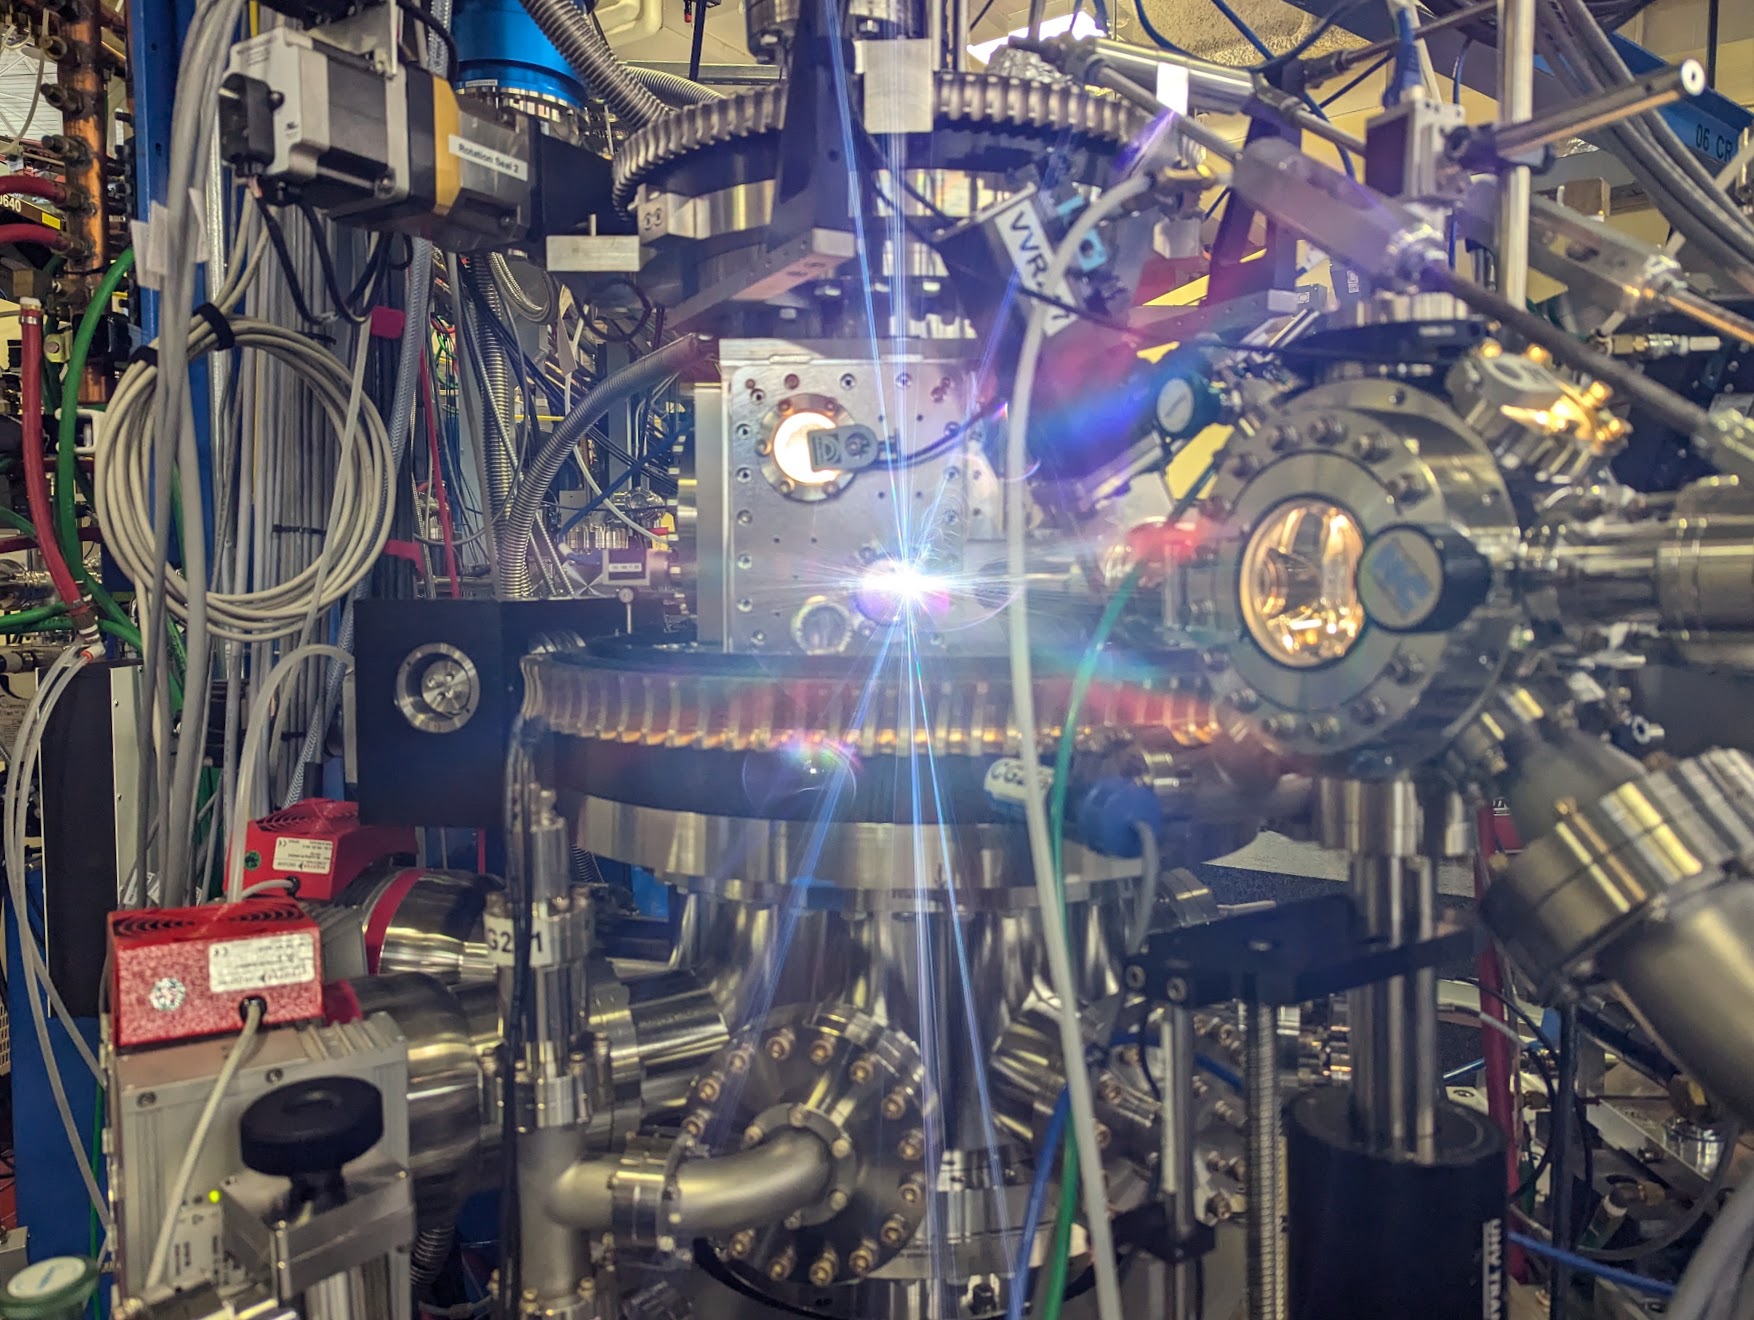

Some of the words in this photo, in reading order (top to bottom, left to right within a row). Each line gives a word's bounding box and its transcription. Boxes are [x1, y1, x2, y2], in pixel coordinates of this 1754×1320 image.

[1695, 123, 1711, 152] 06
[458, 142, 494, 164] Rotation
[495, 156, 513, 172] Seal
[513, 163, 519, 174] 2
[1487, 1218, 1502, 1265] UHV
